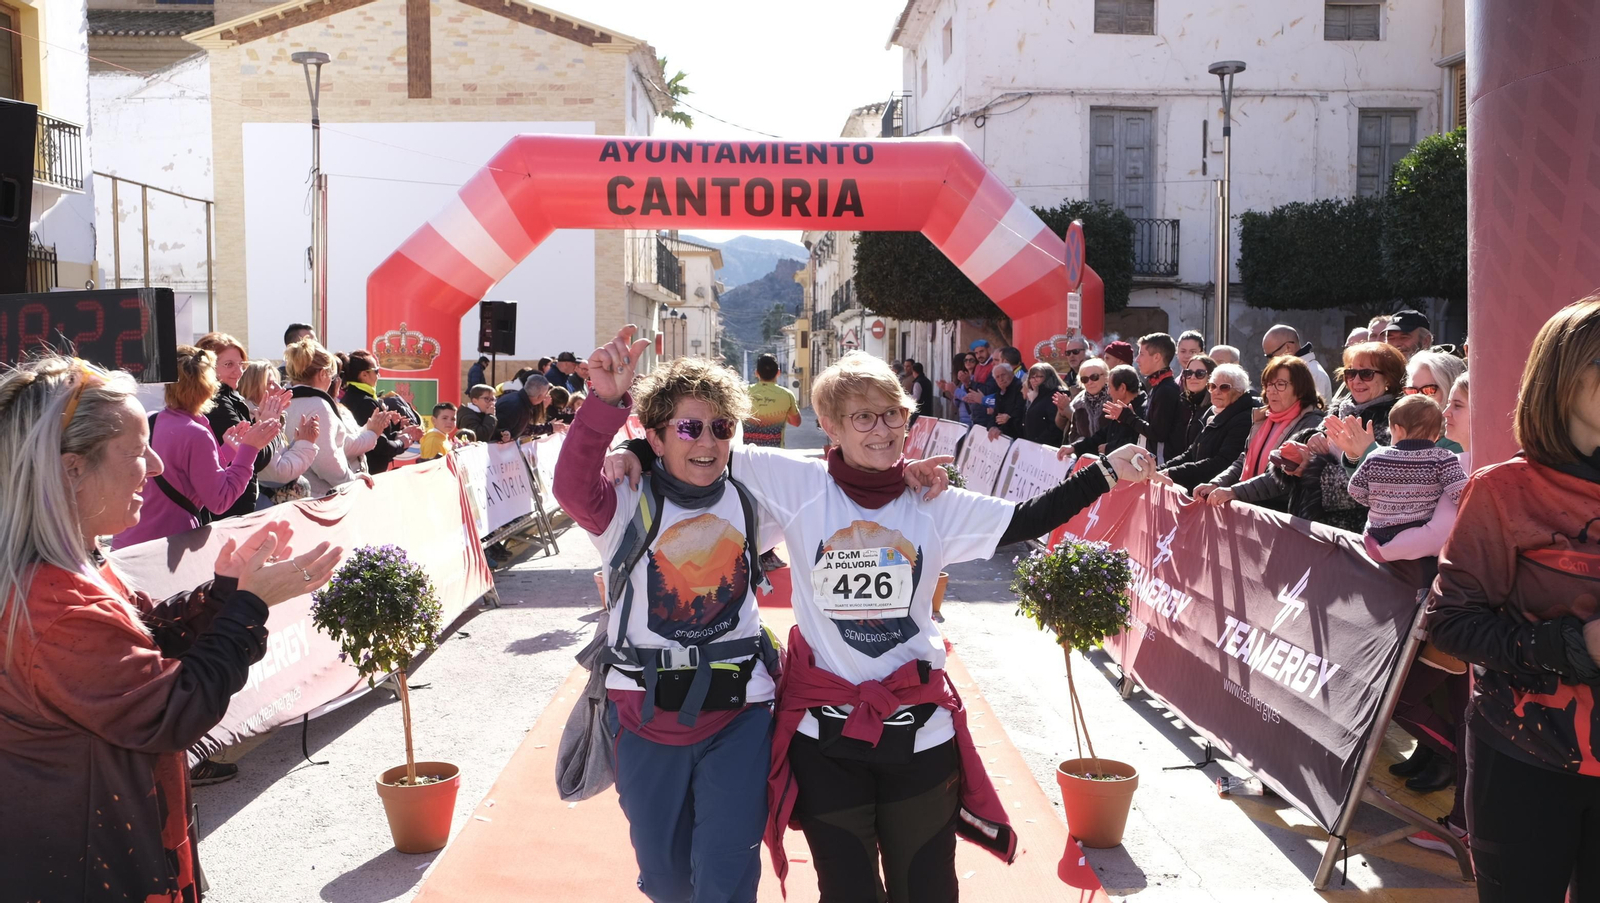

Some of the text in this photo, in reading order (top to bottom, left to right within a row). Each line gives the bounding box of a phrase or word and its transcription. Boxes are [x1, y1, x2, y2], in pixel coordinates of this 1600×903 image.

[599, 141, 874, 165] AYUNTAMIENTO
[606, 175, 865, 218] CANTORIA
[835, 560, 877, 570] PÓLVORA
[838, 551, 860, 560] CxM
[832, 572, 893, 600] 426
[1215, 615, 1341, 699] TEAMERGY
